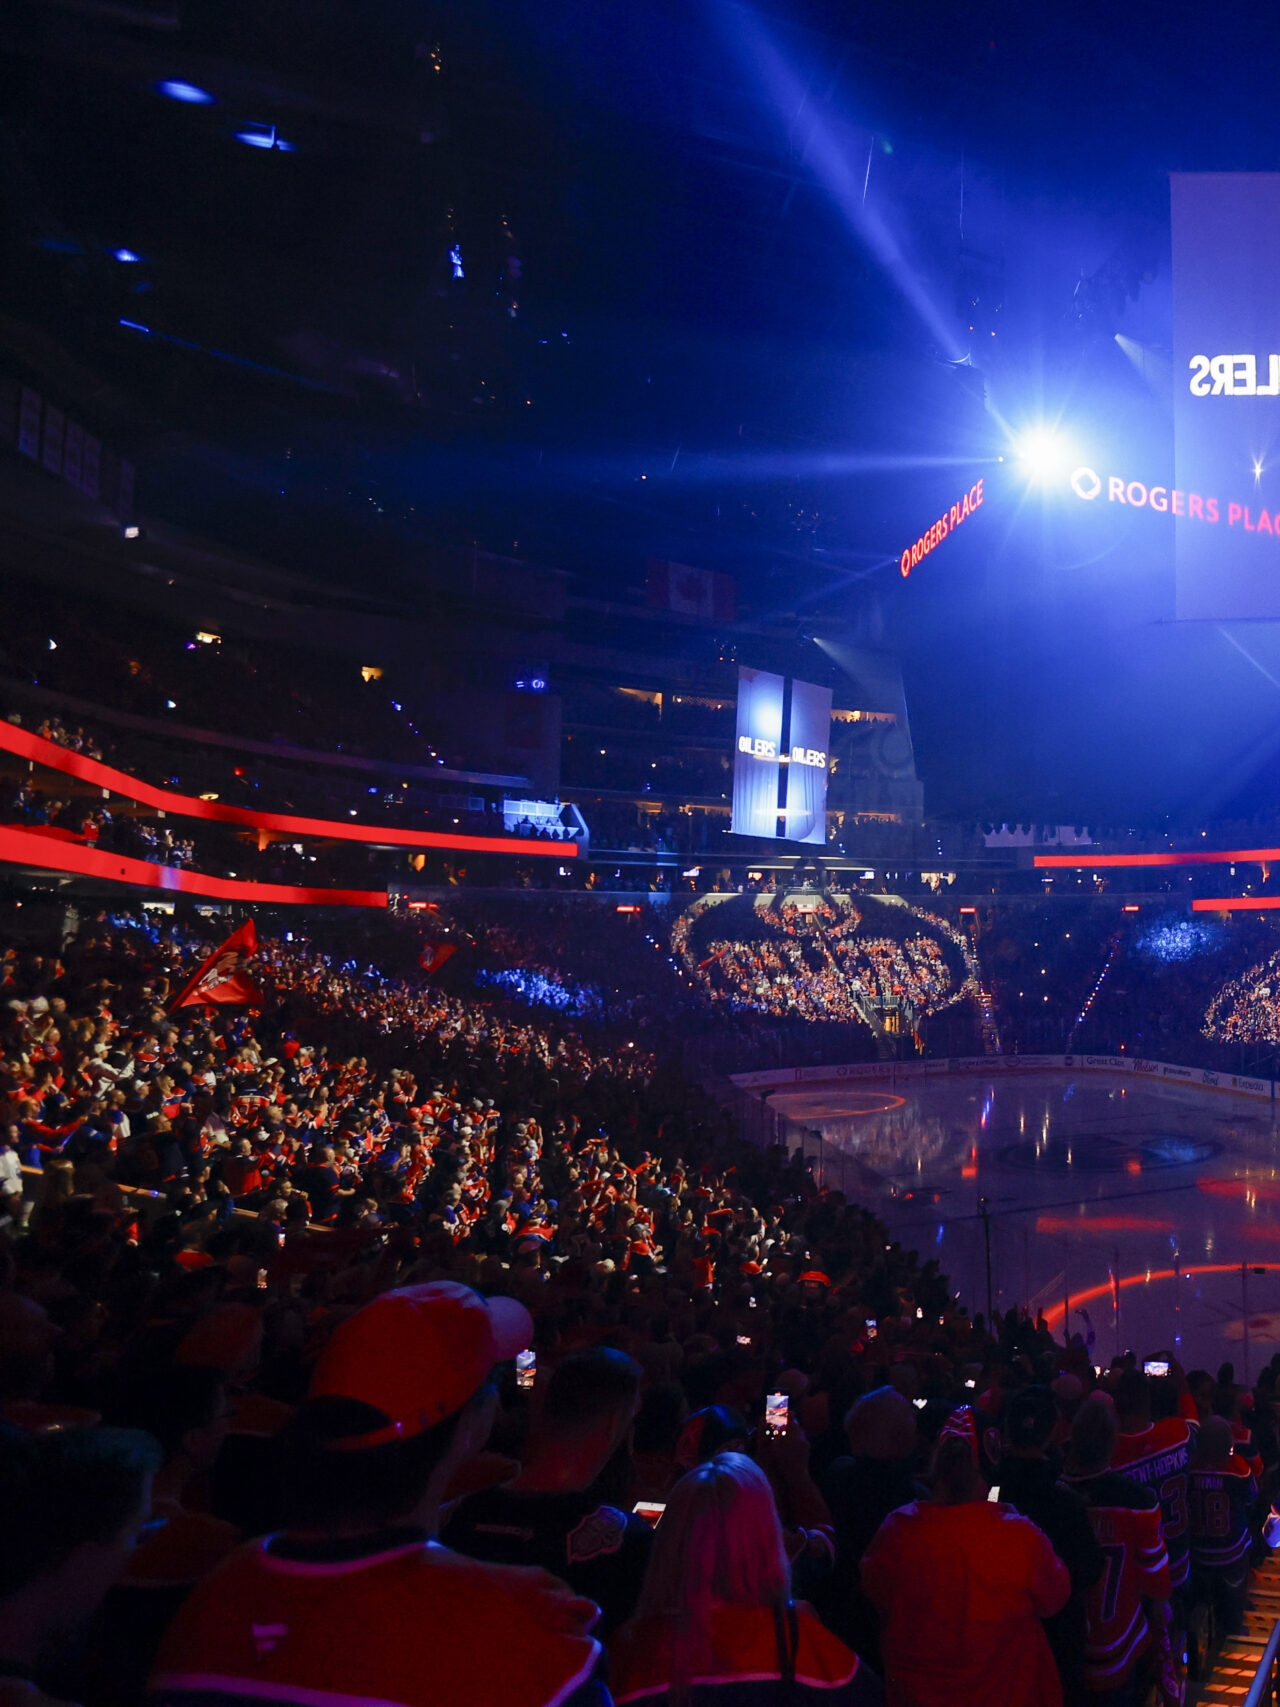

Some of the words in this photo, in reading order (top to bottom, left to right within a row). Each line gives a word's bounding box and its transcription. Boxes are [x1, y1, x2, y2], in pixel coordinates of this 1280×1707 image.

[1108, 476, 1219, 523] ROGERS
[911, 513, 949, 567] ROGERS
[949, 478, 984, 531] PLACE
[738, 736, 776, 757] OILERS
[792, 746, 826, 768] OILERS
